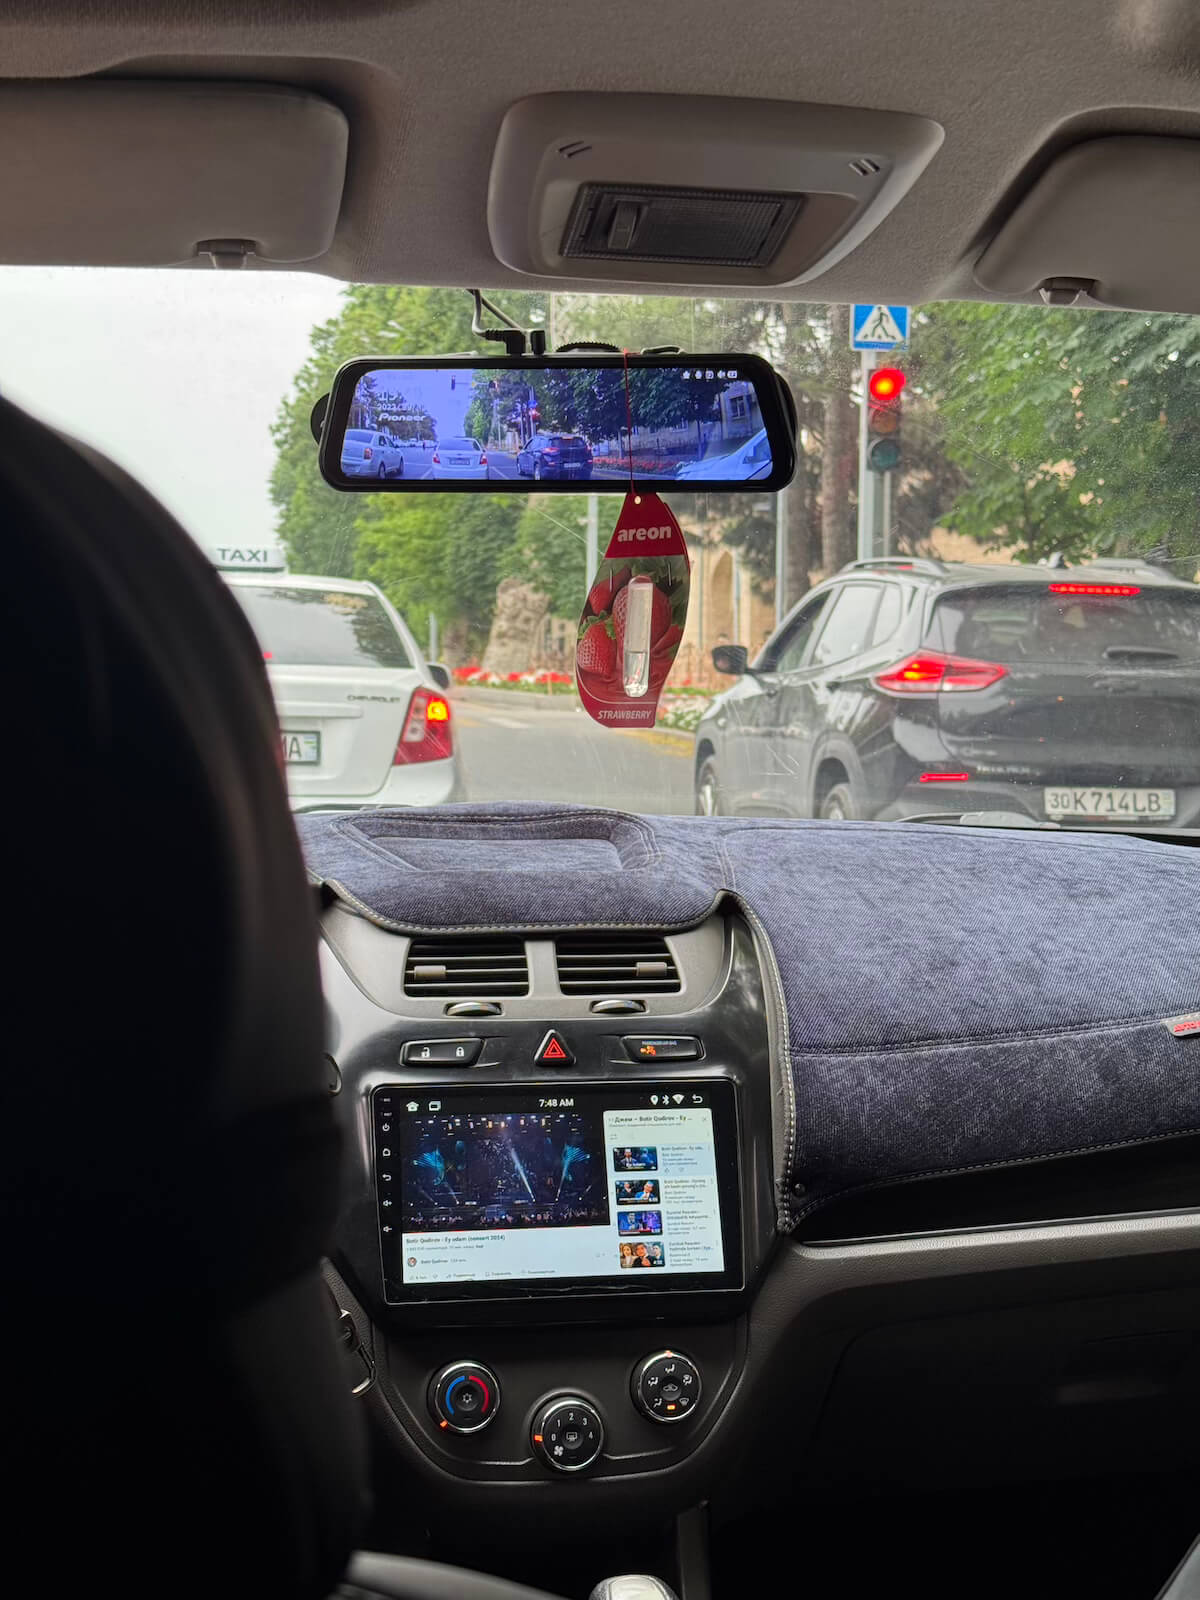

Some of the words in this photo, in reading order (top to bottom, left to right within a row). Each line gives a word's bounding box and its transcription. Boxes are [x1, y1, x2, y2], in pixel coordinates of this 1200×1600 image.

[379, 413, 426, 422] Pioneer
[617, 526, 672, 542] areon
[216, 548, 268, 562] TAXI
[597, 710, 652, 721] STRAWBERRY
[538, 1098, 558, 1108] 7:48
[559, 1098, 575, 1107] AM
[551, 1433, 556, 1441] 0
[557, 1419, 561, 1427] 1
[569, 1412, 574, 1421] 2
[582, 1417, 588, 1426] 3
[588, 1431, 594, 1439] 4
